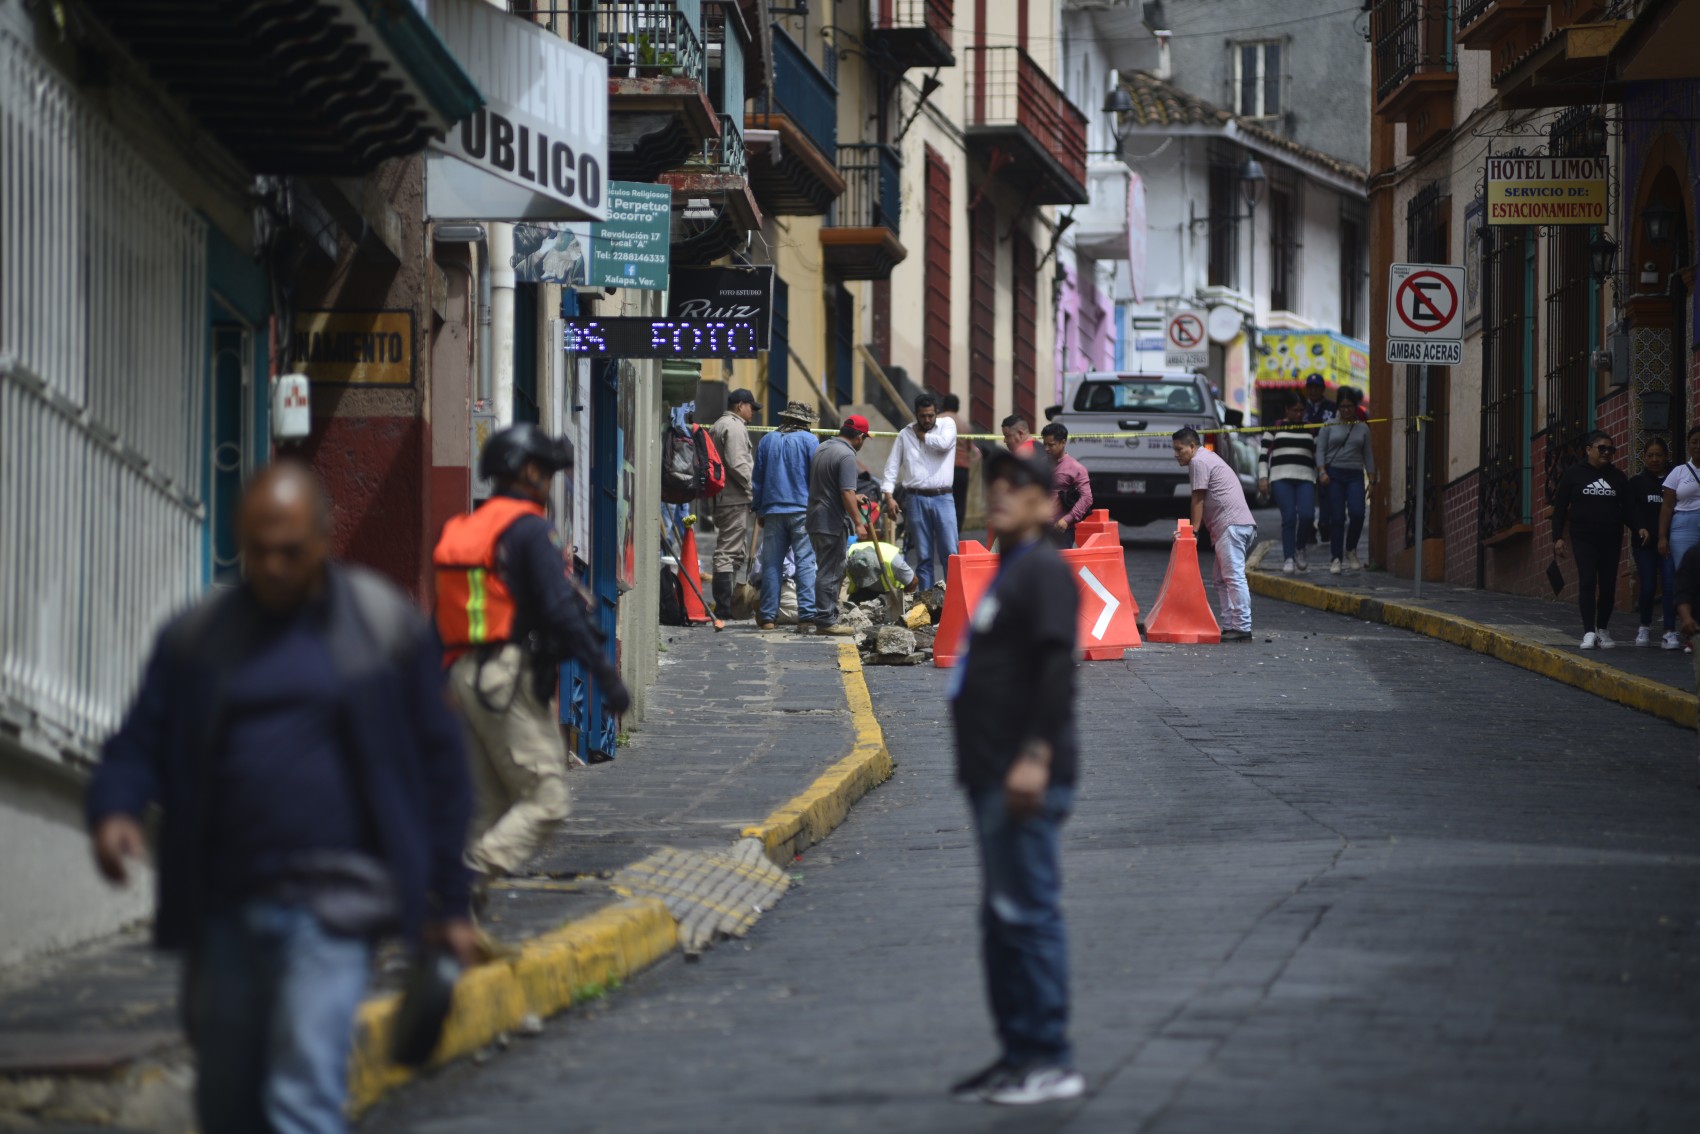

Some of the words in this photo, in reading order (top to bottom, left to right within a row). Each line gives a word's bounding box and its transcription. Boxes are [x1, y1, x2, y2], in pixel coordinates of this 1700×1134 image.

[435, 105, 601, 209] UBLICO
[1490, 160, 1545, 180] HOTEL
[1551, 159, 1604, 180] LIMON
[631, 189, 669, 199] Religiosos
[1505, 187, 1564, 197] SERVICIO
[1568, 187, 1589, 197] DE:
[614, 199, 669, 213] Perpetuo
[1492, 203, 1603, 218] ESTACIONAMIENTO
[601, 229, 649, 241] Revolución
[650, 232, 661, 241] 17
[595, 250, 611, 260] Tel:
[638, 277, 656, 287] Ver.
[1389, 343, 1421, 360] AMBAS
[1423, 344, 1459, 361] ACERAS
[1582, 487, 1616, 496] adidas
